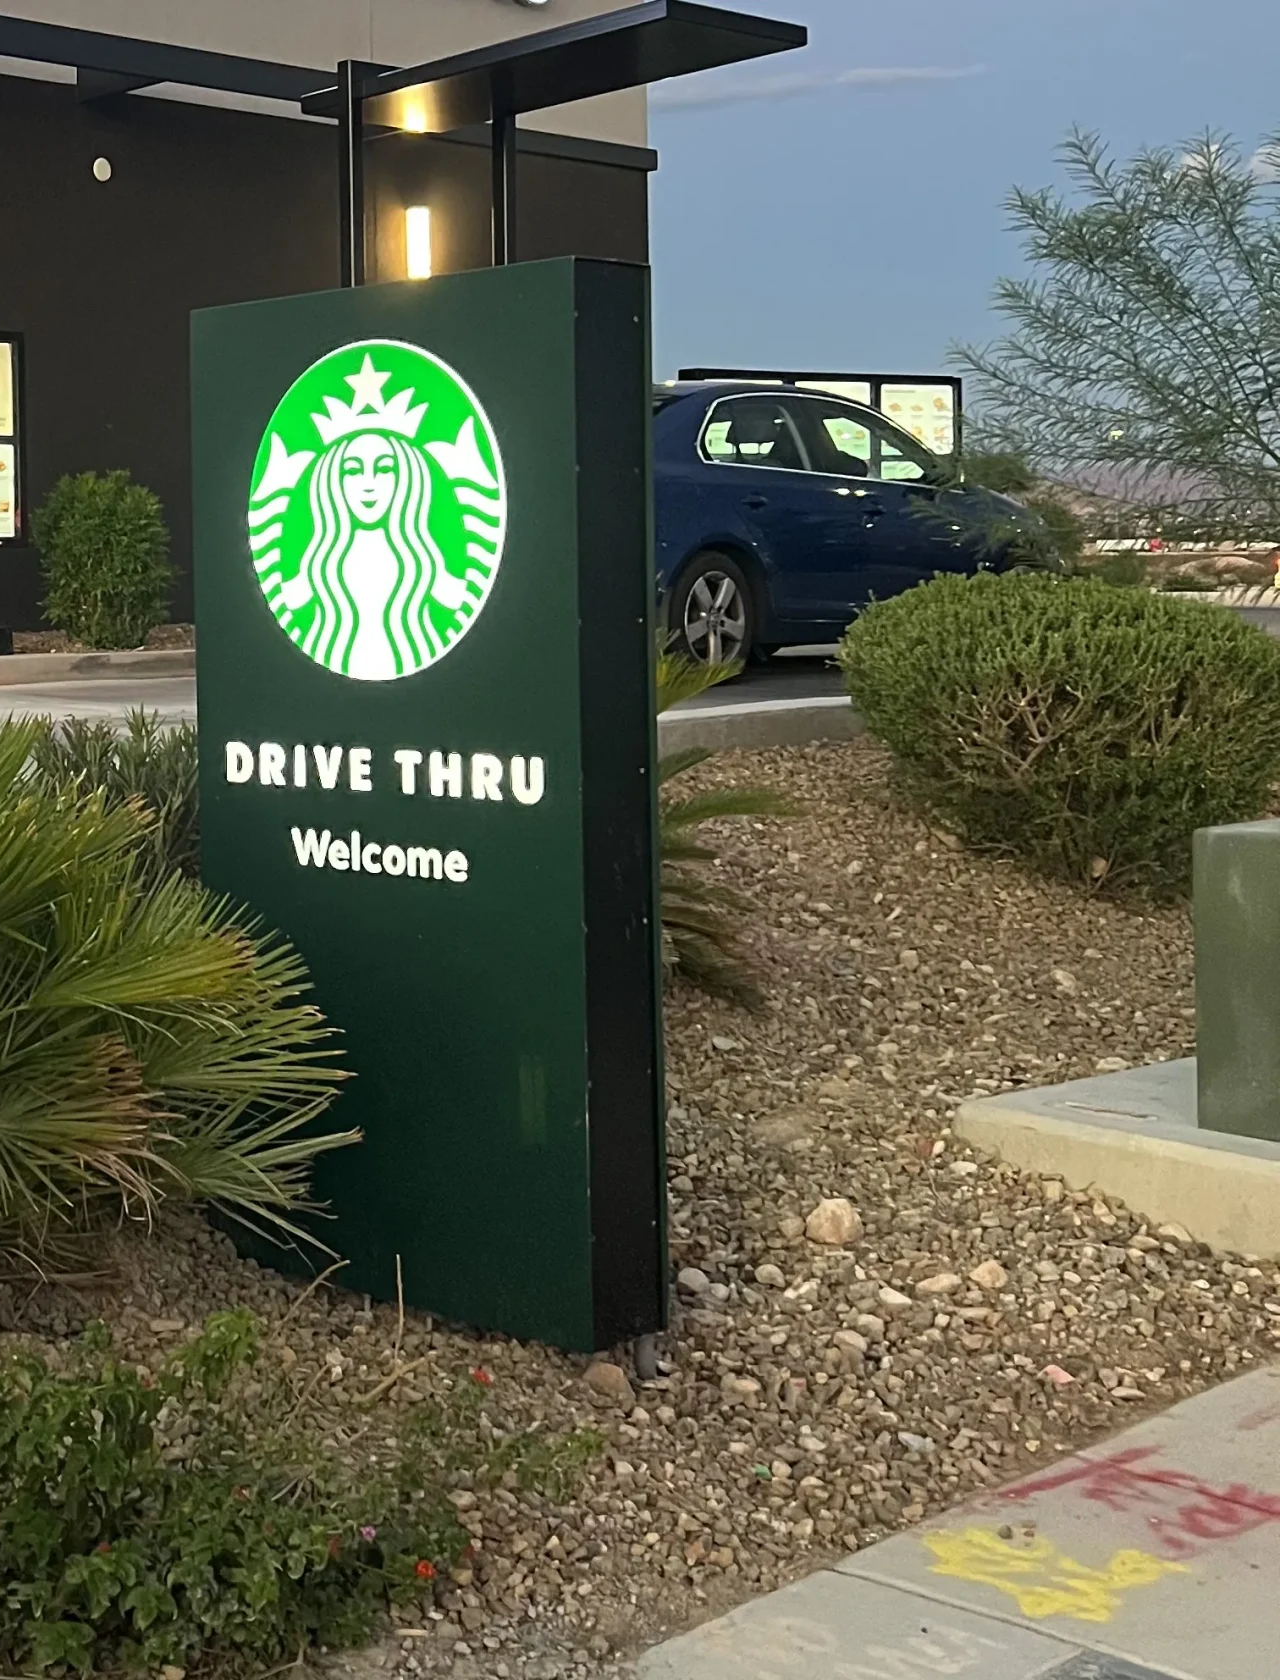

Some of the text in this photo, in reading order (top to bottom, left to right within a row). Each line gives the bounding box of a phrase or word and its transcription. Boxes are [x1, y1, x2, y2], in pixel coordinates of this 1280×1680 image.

[225, 740, 546, 805] DRIVE THRU
[290, 826, 469, 883] Welcome
